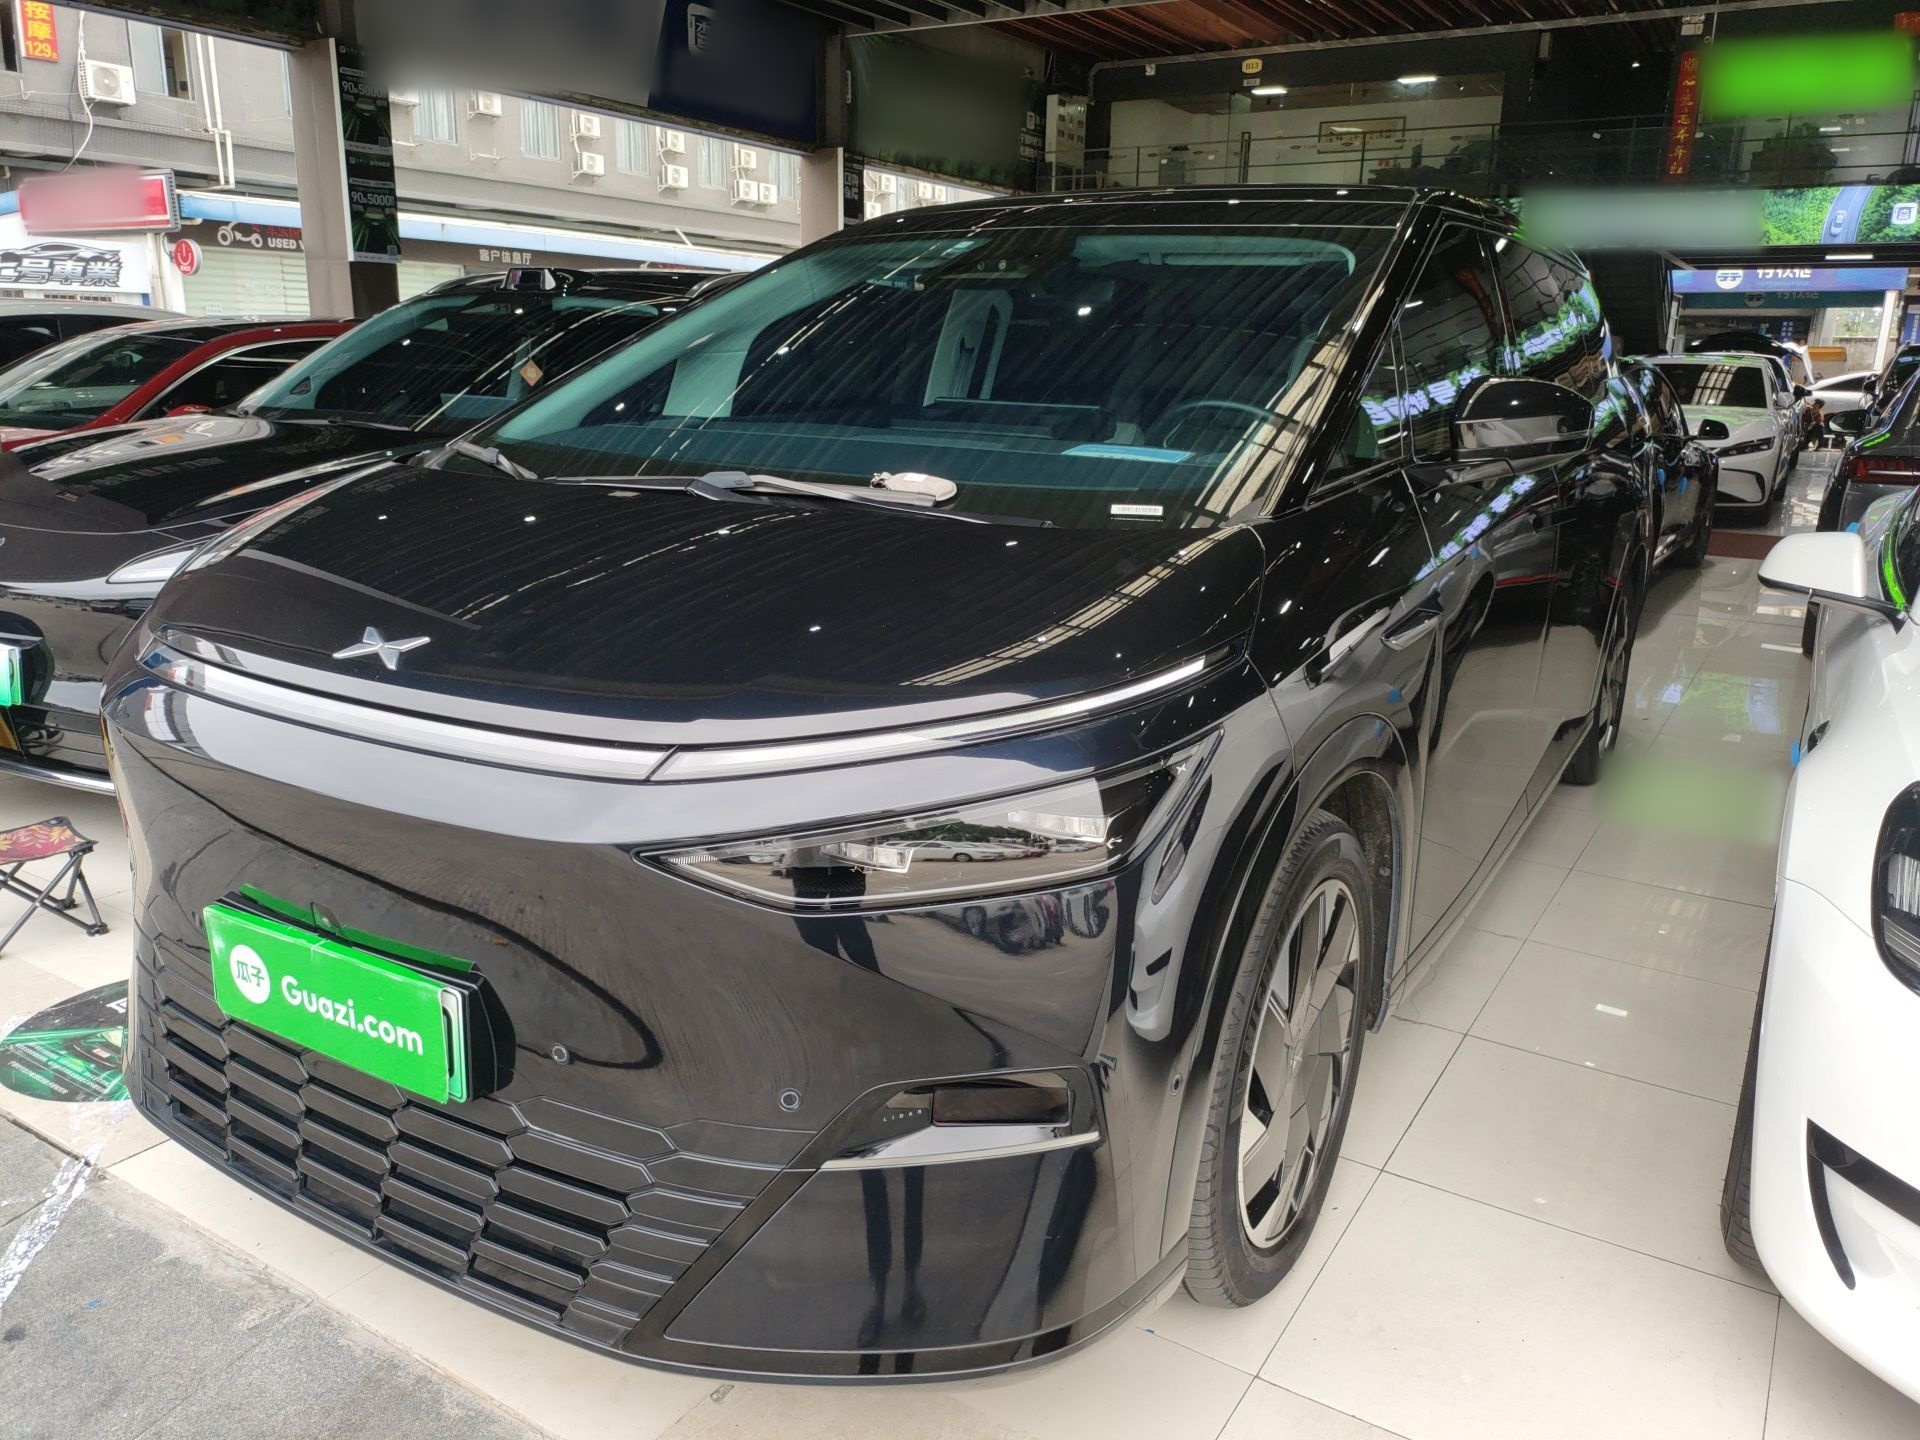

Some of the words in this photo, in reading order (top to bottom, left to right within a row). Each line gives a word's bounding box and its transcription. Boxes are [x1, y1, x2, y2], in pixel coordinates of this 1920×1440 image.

[25, 0, 53, 40] 按摩
[267, 237, 297, 249] USED
[479, 248, 532, 265] 客户休息厅
[235, 959, 265, 988] 瓜子
[281, 974, 424, 1057] Guazi.com
